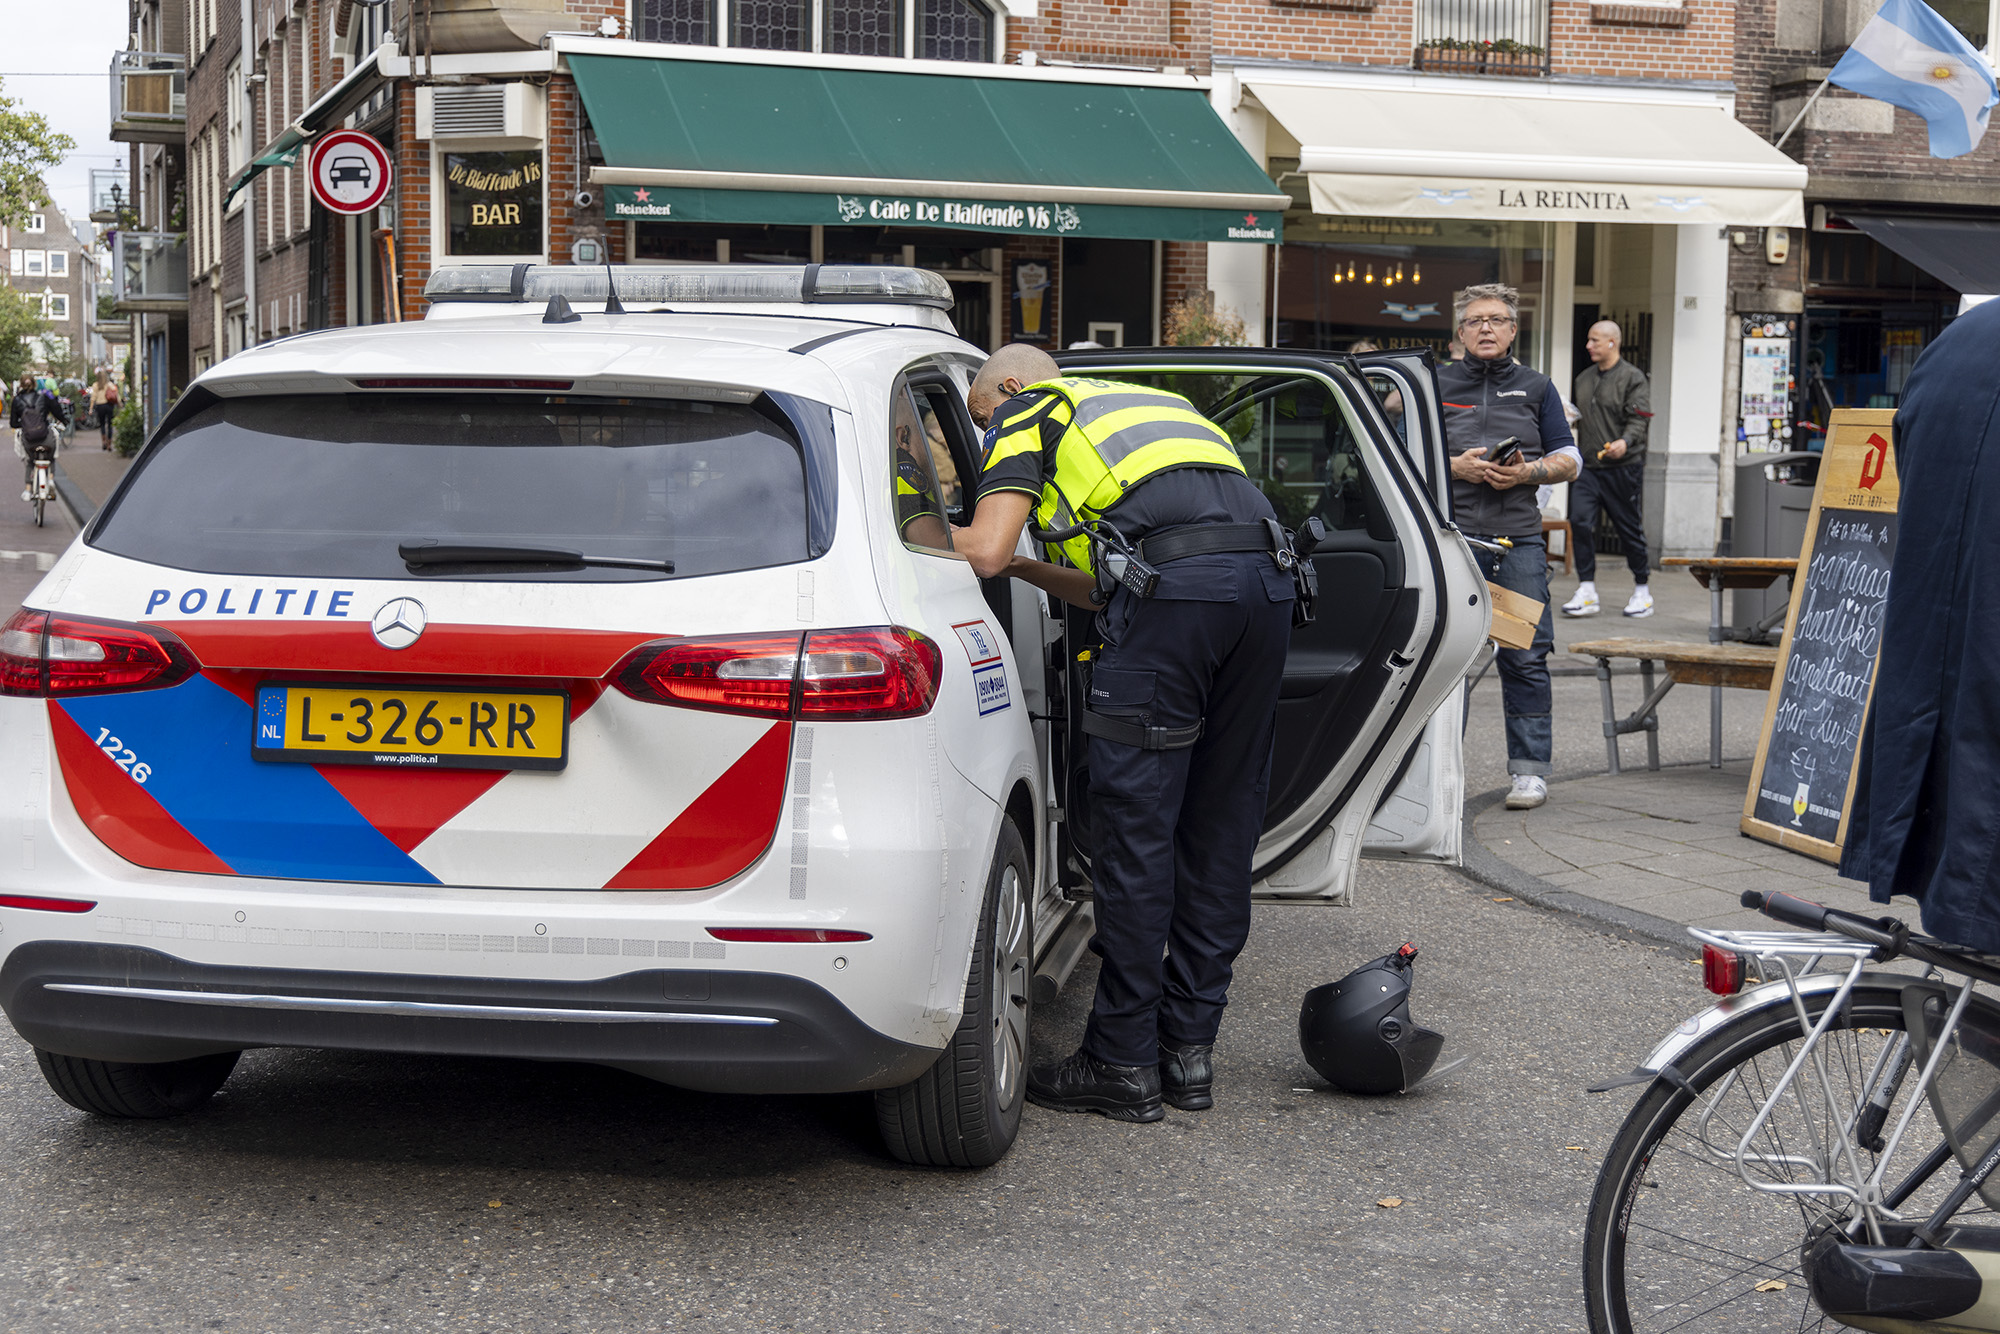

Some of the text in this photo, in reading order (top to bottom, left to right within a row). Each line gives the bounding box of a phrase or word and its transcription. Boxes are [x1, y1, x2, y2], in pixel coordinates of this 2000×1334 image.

[448, 161, 541, 192] De Blaffende Vis
[615, 203, 672, 216] Heineken
[1498, 189, 1631, 211] LA REINITA
[471, 203, 521, 226] BAR
[916, 201, 940, 222] De
[943, 203, 1025, 228] Blaffende
[1026, 206, 1051, 230] Vis
[1228, 227, 1275, 240] Heineken
[144, 588, 354, 618] POLITIE
[301, 696, 537, 750] L-326-RR
[1777, 698, 1808, 736] van
[262, 724, 282, 739] NL
[95, 726, 153, 784] 1226
[374, 753, 439, 766] www.politie.nl
